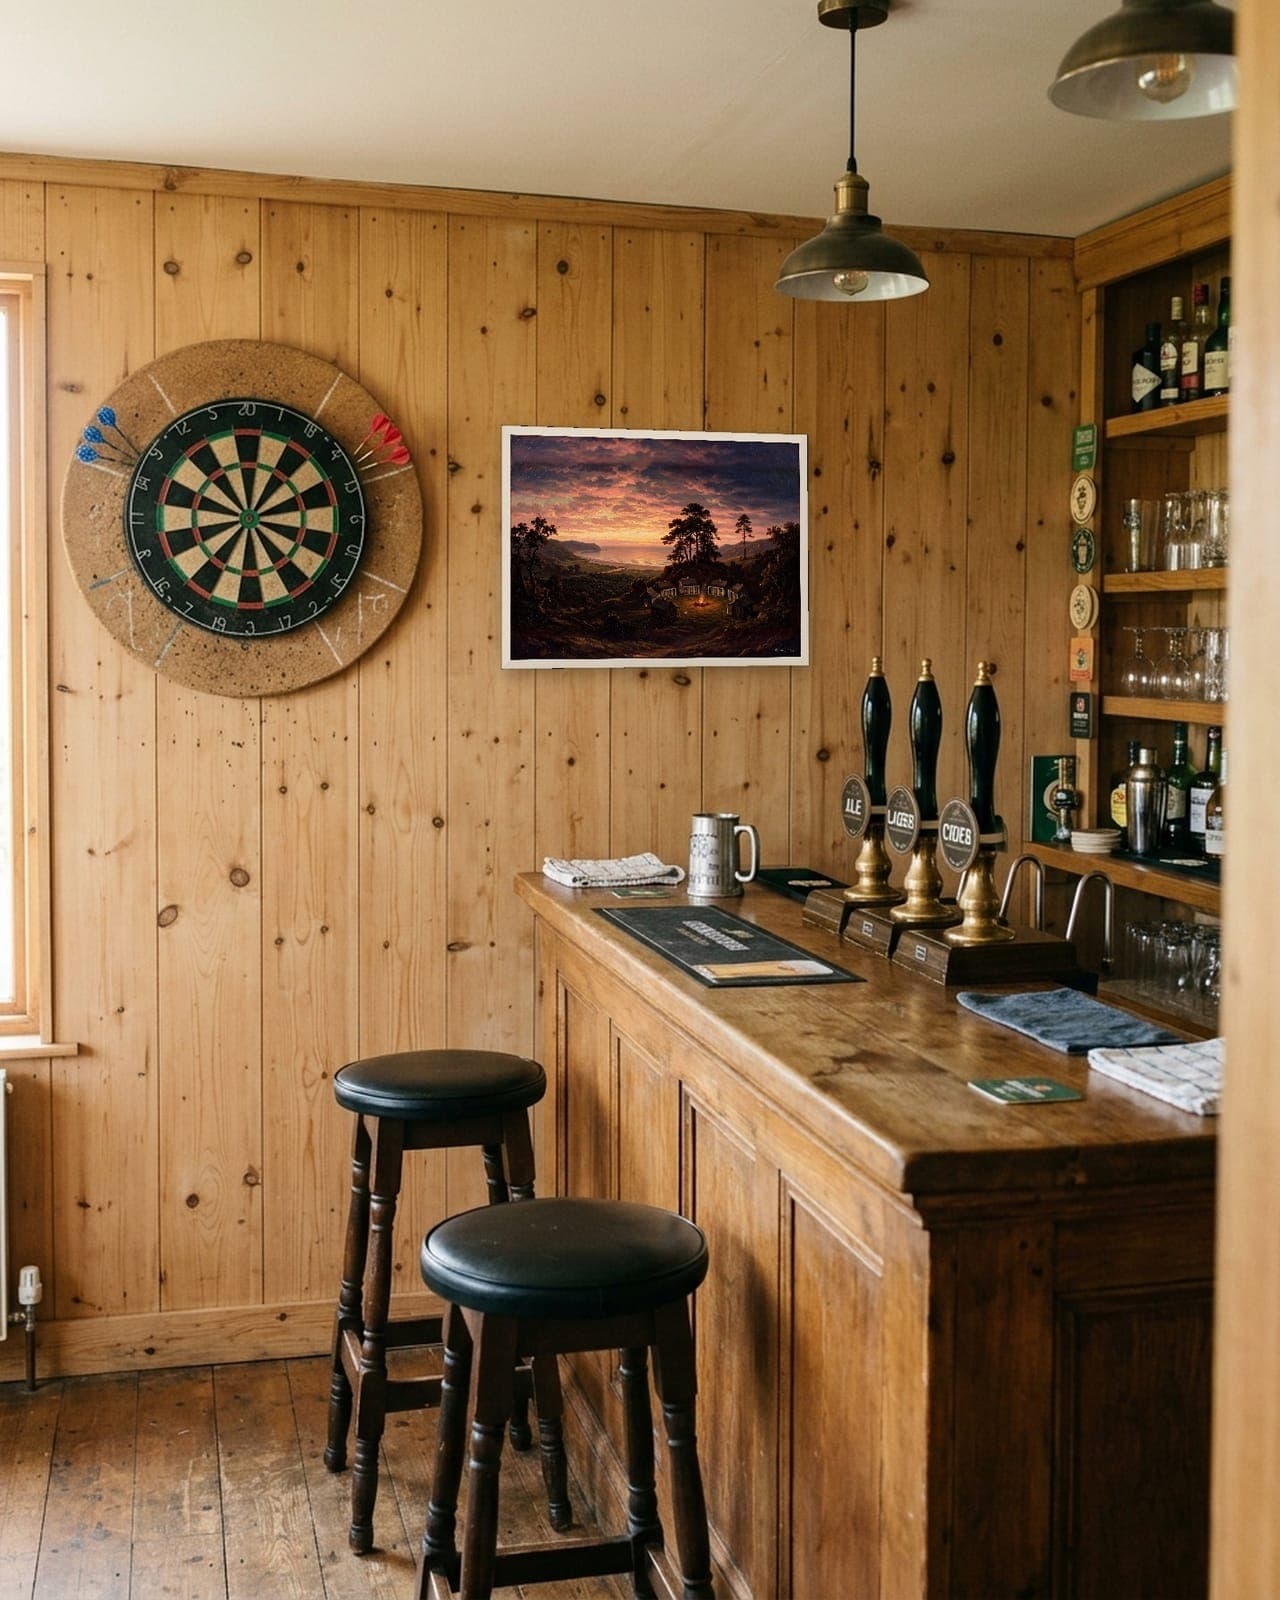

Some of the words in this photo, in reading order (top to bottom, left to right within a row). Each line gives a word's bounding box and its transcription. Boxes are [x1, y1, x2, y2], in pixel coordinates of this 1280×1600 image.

[207, 407, 218, 420] 5
[238, 402, 256, 416] 20
[278, 408, 284, 421] 1
[175, 421, 192, 436] 12
[149, 448, 163, 460] 9
[331, 449, 341, 461] 4
[131, 511, 144, 524] 11
[349, 515, 364, 524] 6
[344, 544, 360, 559] 10
[330, 573, 348, 589] 15
[183, 601, 194, 614] 7
[211, 617, 226, 632] 19
[278, 615, 291, 630] 17
